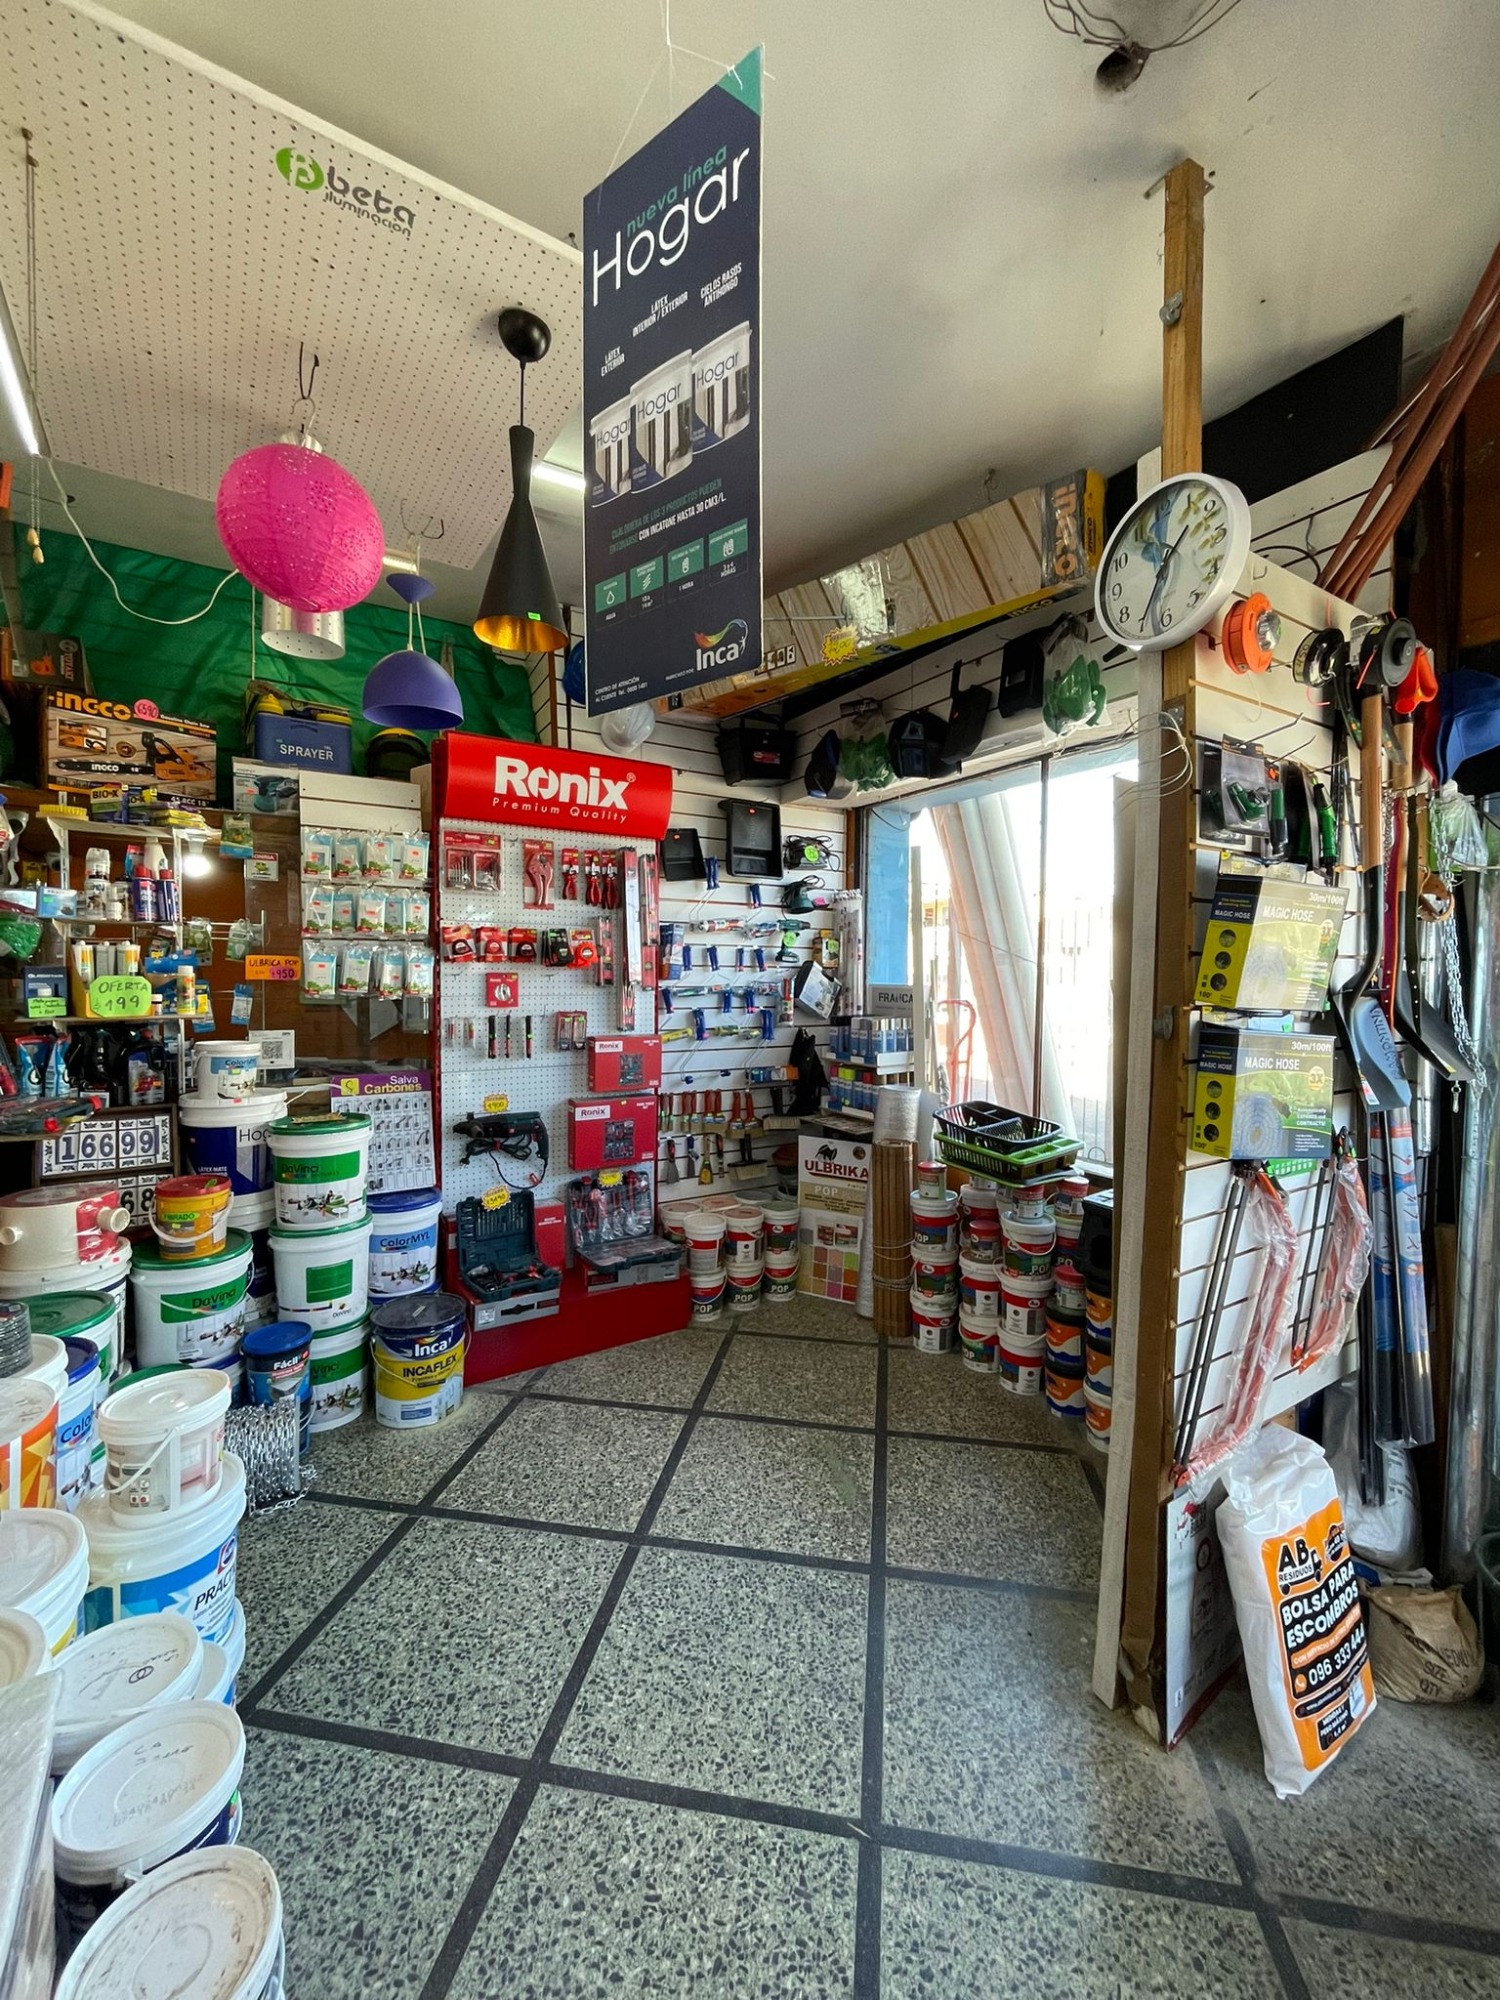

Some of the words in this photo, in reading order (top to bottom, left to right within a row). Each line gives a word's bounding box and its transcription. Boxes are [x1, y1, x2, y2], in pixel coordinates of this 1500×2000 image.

[327, 166, 416, 229] beta
[627, 184, 678, 237] nueva
[683, 145, 728, 193] línea
[593, 147, 750, 307] Hogar
[701, 276, 721, 299] CIELOS
[722, 262, 742, 285] RASOS
[704, 276, 739, 308] ANTIHONGO
[633, 313, 657, 337] INTERIOR
[662, 291, 688, 317] EXTERIOR
[601, 353, 625, 377] EXTERIOR
[697, 352, 739, 388] Hogar
[637, 383, 682, 421] Hogar
[596, 417, 632, 446] Hogar
[638, 528, 650, 540] CON
[677, 506, 695, 523] HASTA
[696, 502, 704, 514] 30
[1113, 552, 1128, 572] 10
[1112, 583, 1122, 601] 9
[1186, 589, 1201, 609] 5
[1119, 606, 1130, 623] 8
[1161, 608, 1172, 627] 6
[696, 642, 739, 671] Inca
[280, 743, 334, 761] SPRAYER
[495, 755, 629, 811] Ronix
[92, 789, 118, 799] BIO-X
[492, 797, 560, 815] Premium
[570, 806, 628, 824] Quality
[1214, 909, 1233, 918] MAGIC
[1263, 905, 1290, 919] MAGIC
[1291, 908, 1315, 922] HOSE
[98, 981, 149, 994] OFERTA
[599, 1042, 619, 1050] Ronix
[1291, 1041, 1332, 1053] 30m/100ft
[1245, 1056, 1273, 1069] MAGIC
[1275, 1058, 1300, 1070] HOSE
[390, 1075, 419, 1085] Salva
[1310, 1073, 1323, 1084] 3X
[364, 1083, 422, 1094] Carbones
[580, 1107, 606, 1117] Ronix
[281, 1164, 319, 1173] DaVinci
[804, 1160, 869, 1178] ULBRIKA
[814, 1185, 839, 1196] POP
[379, 1231, 431, 1249] ColorMYL
[192, 1286, 237, 1310] DaVinci
[770, 1285, 789, 1293] POP
[734, 1294, 753, 1303] POP
[693, 1304, 713, 1313] POP
[415, 1340, 447, 1357] Inca
[273, 1356, 299, 1370] Fácil
[403, 1352, 458, 1377] INCAFLEX
[1279, 1539, 1309, 1573] AB
[1279, 1564, 1313, 1582] RESIDUOS
[1328, 1560, 1355, 1597] PARA
[1281, 1588, 1330, 1626] BOLSA
[1286, 1580, 1359, 1649] ESCOMBROS
[1309, 1658, 1332, 1685] 096
[1334, 1642, 1351, 1669] 333
